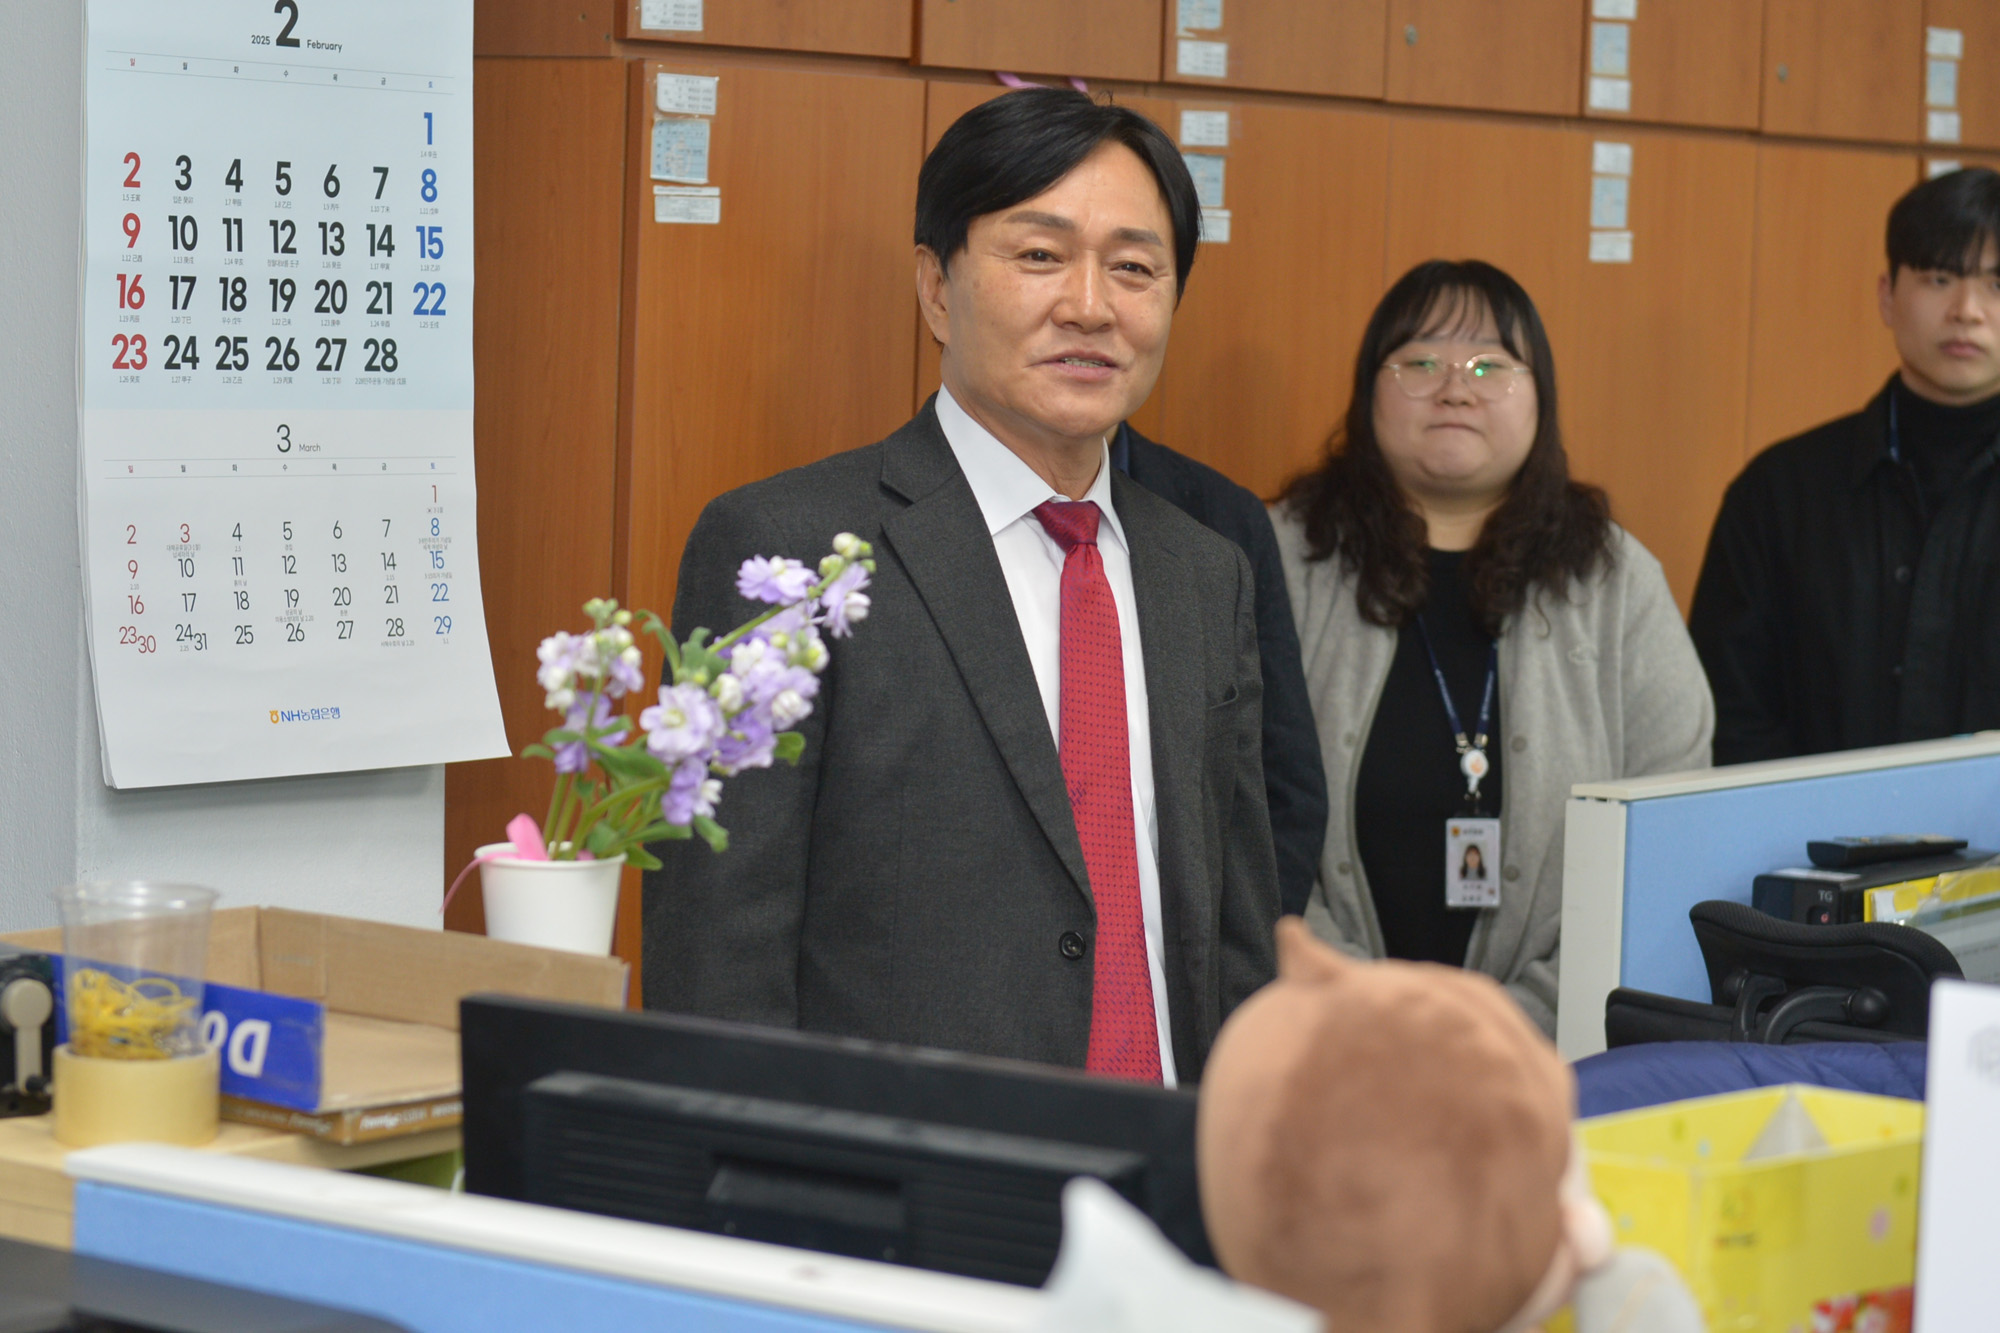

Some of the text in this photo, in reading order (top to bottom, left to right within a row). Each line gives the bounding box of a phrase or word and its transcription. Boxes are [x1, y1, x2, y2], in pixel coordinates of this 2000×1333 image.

[251, 0, 342, 53] 2025 2 February
[424, 112, 432, 145] 1
[124, 152, 437, 202] 2 3 4 5 6 7 8
[123, 213, 444, 259] 9 10 11 12 13 14 15
[117, 274, 446, 316] 16 17 18 19 20 21 22
[112, 334, 398, 372] 23 24 25 26 27 28
[277, 424, 321, 453] 3 March
[432, 485, 436, 503] 1
[127, 518, 440, 544] 2 3 4 5 6 7 8
[128, 551, 444, 579] 9 10 11 12 13 14 15
[128, 583, 449, 614] 16 17 18 19 20 21 22
[119, 616, 452, 653] 23 30 24 31 25 26 27 28 29
[281, 706, 342, 722] NH농협은행
[1819, 889, 1833, 903] TG
[203, 1011, 271, 1077] Do
